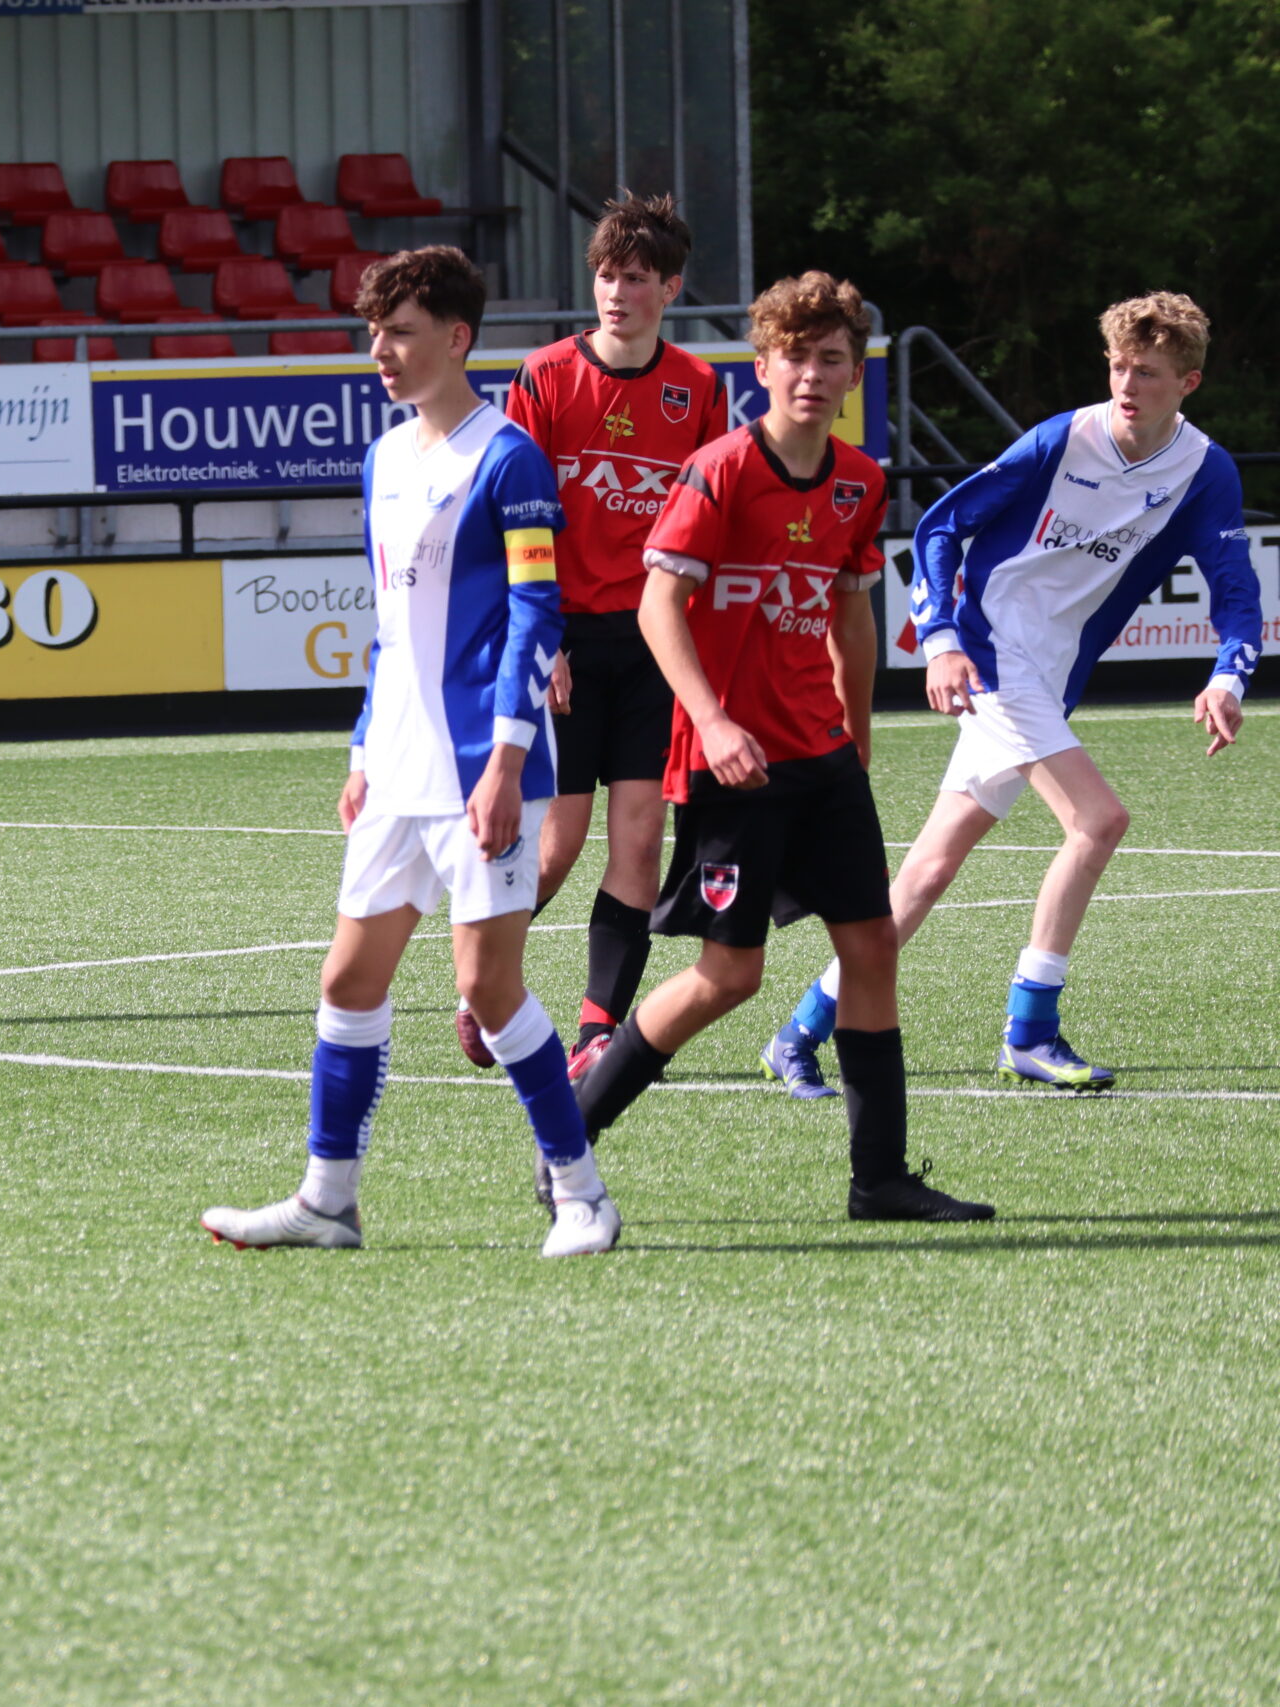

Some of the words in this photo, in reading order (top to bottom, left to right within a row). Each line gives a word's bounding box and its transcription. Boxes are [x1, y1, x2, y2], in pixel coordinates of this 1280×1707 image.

[117, 460, 259, 483] Elektrotechniek
[557, 459, 677, 494] PAX
[713, 571, 833, 611] PAX
